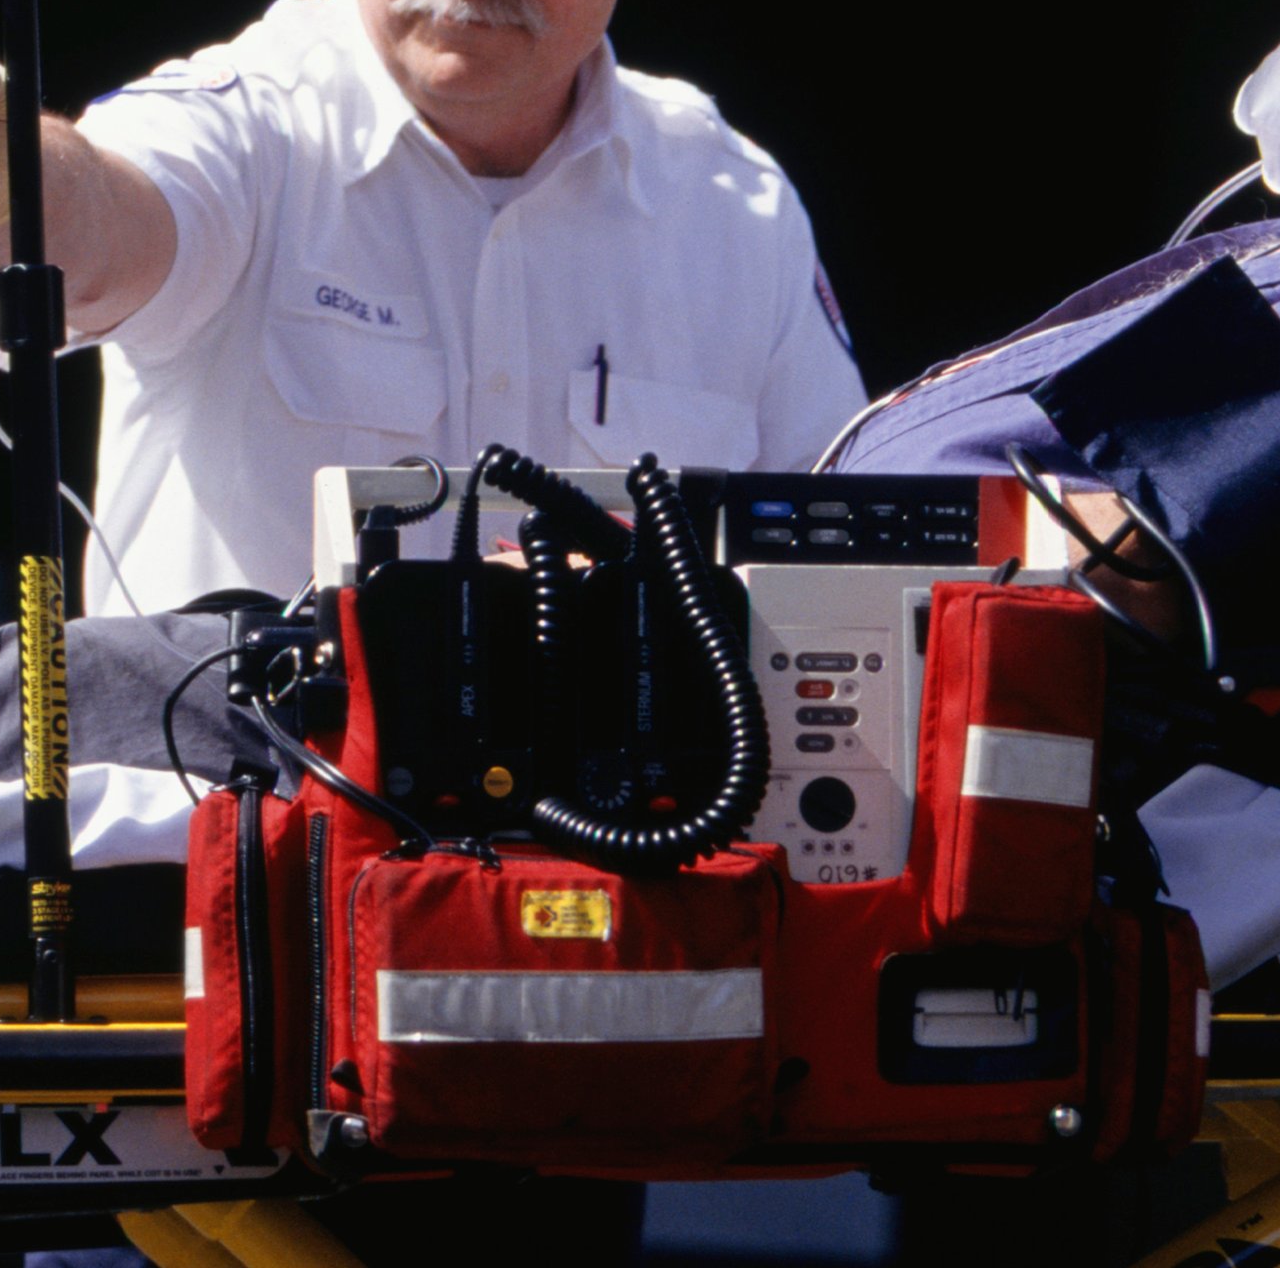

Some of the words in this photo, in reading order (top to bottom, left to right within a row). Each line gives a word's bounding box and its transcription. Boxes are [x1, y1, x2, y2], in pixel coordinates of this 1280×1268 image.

[39, 566, 48, 582] DO
[39, 587, 49, 609] NOT
[40, 614, 49, 636] USE
[29, 611, 38, 672] EQUIPMENT
[41, 661, 50, 691] POLE
[50, 593, 69, 765] CAUTION
[30, 676, 39, 721] DAMAGE
[41, 696, 50, 710] AS
[461, 684, 475, 717] APEX
[637, 671, 652, 732] STERNUM
[42, 715, 51, 724] A
[31, 725, 40, 747] MAY
[31, 750, 40, 788] OCCUR
[818, 864, 878, 883] #610
[0, 1109, 122, 1167] LX
